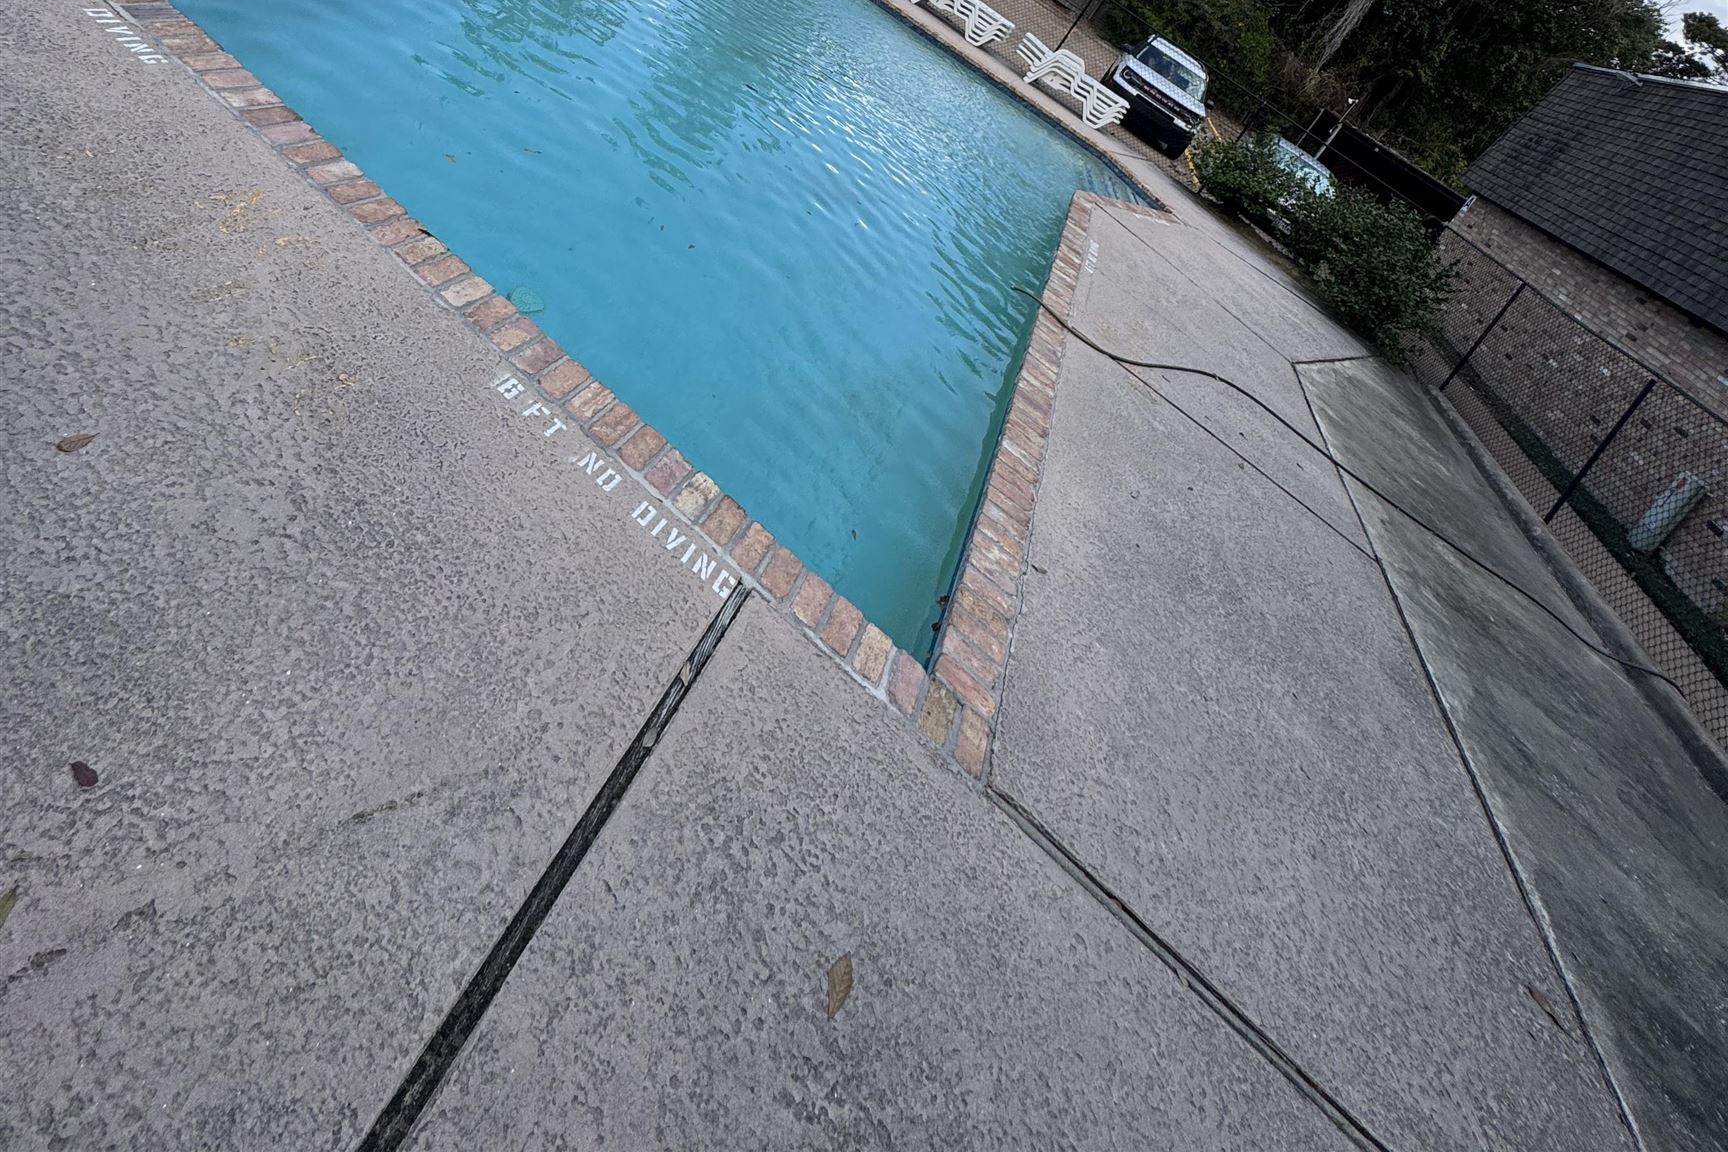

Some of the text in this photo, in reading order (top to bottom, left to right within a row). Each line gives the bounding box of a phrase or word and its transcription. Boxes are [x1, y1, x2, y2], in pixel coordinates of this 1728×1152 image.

[83, 8, 169, 64] DIVING
[522, 400, 567, 437] FT
[577, 451, 623, 492] NO
[631, 500, 736, 598] DIVING
